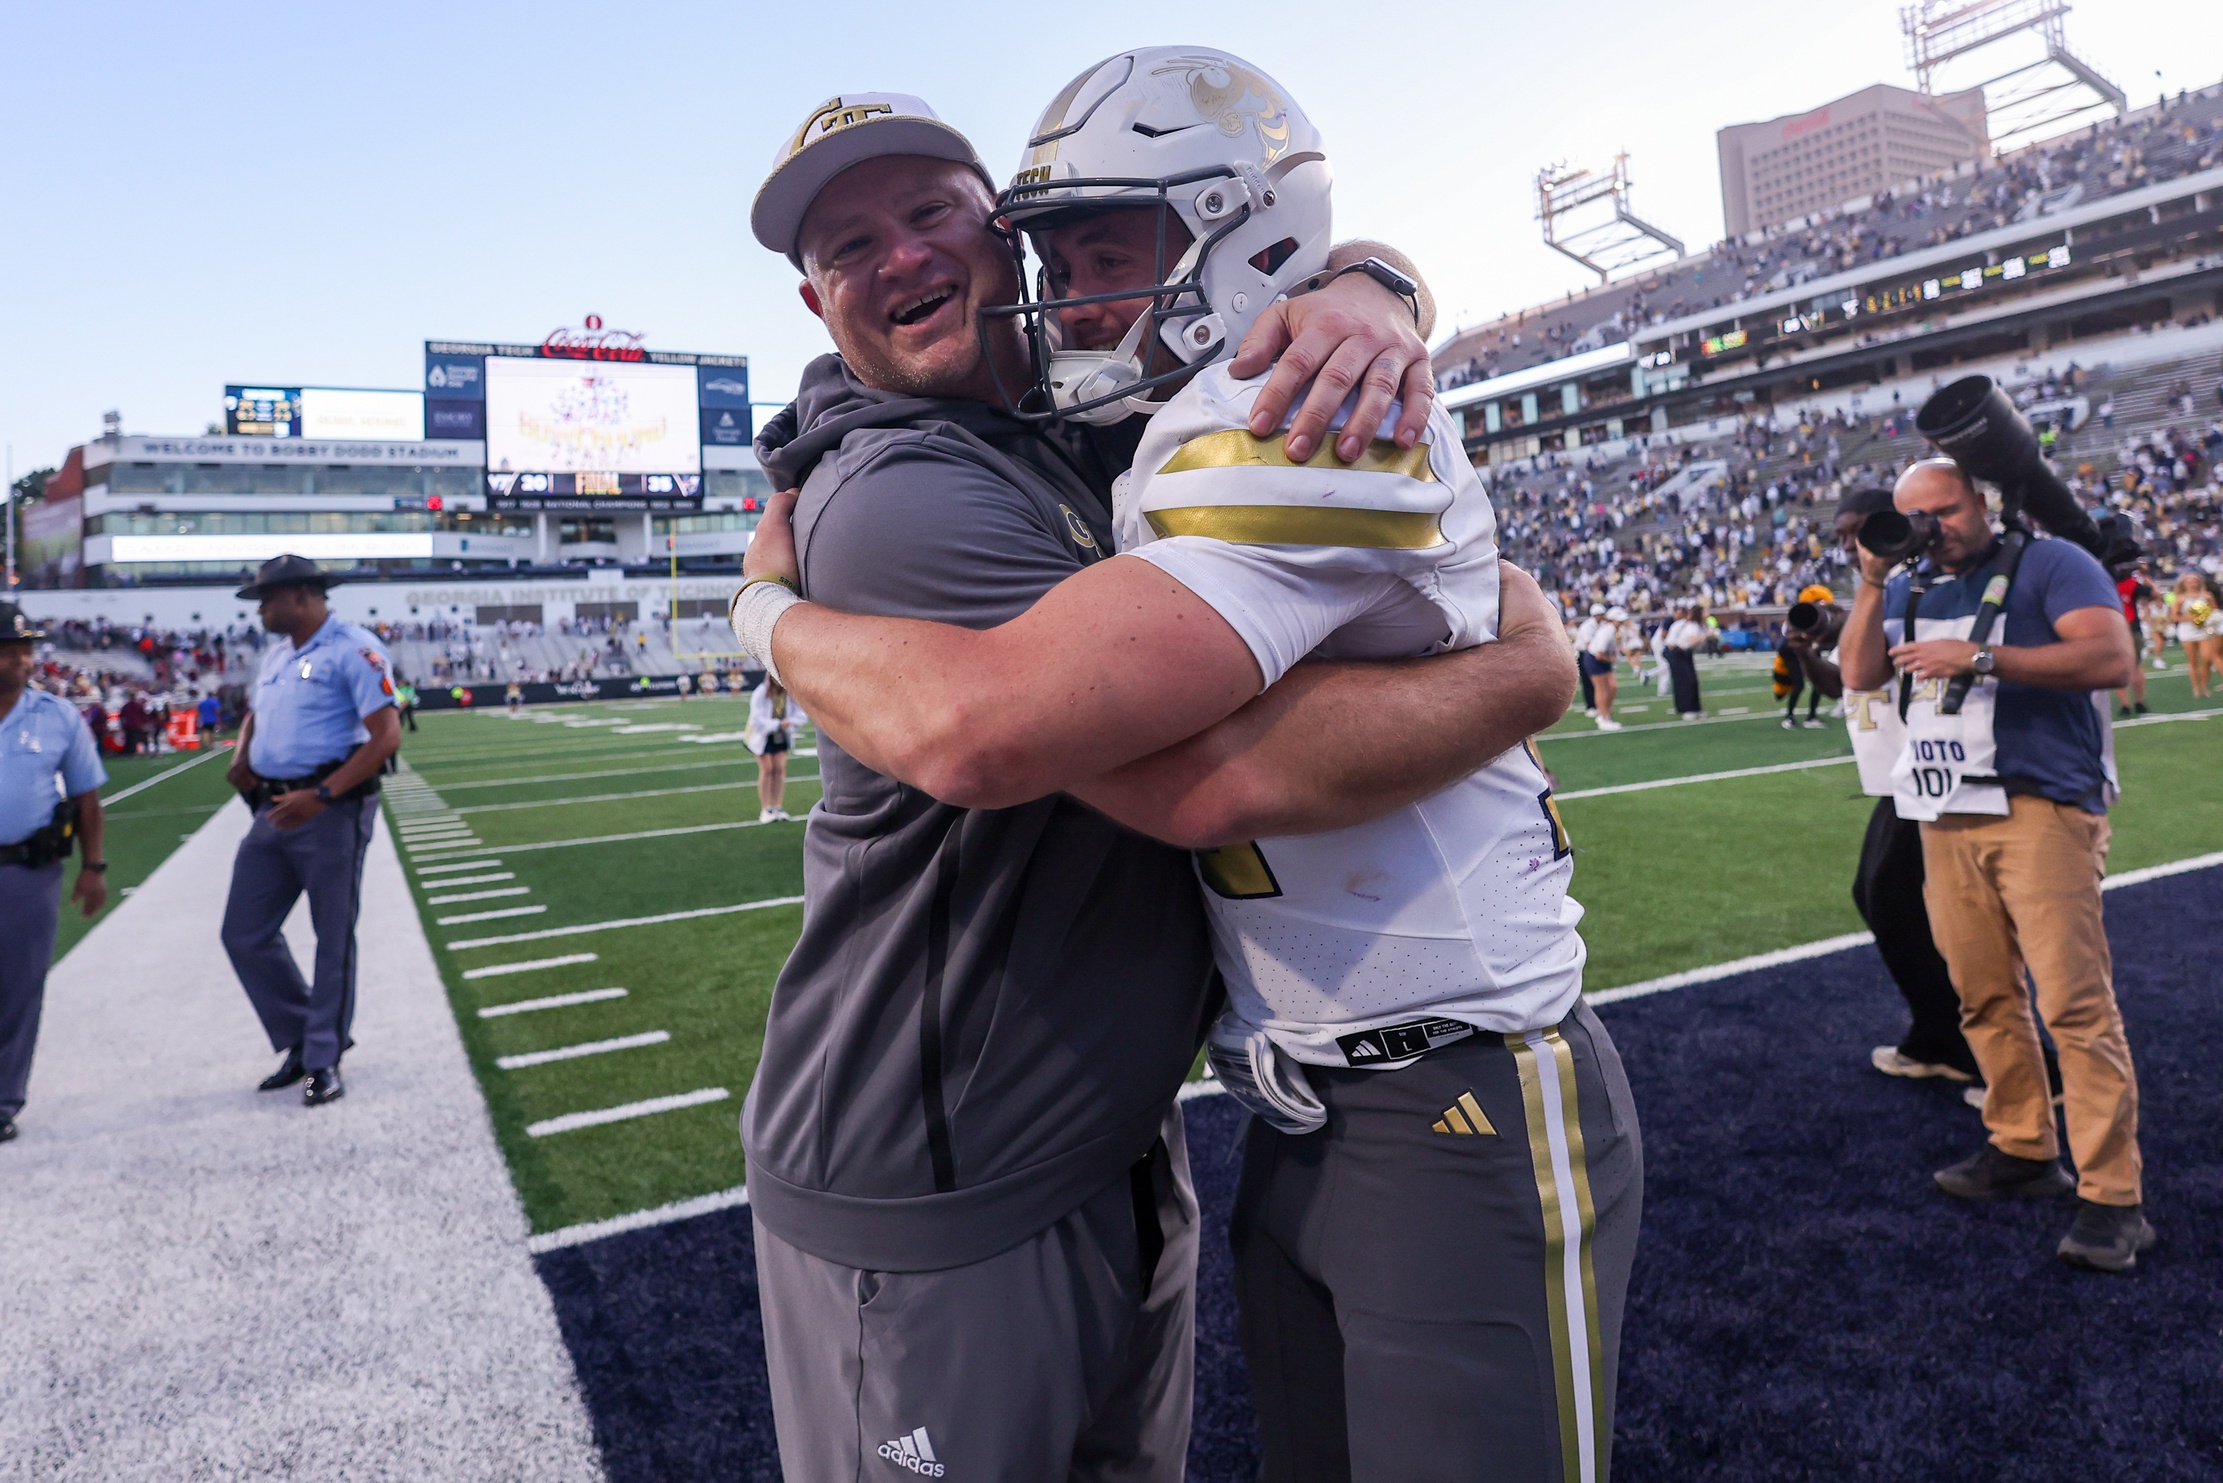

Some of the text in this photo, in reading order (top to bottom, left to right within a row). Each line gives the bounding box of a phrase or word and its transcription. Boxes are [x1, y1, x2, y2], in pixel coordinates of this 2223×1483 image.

[1015, 165, 1051, 201] TECH
[429, 342, 535, 356] GEORGIA TECH
[541, 328, 647, 362] Coca-Cola
[650, 351, 747, 368] YELLOW JACKETS
[143, 443, 459, 459] WELCOME TO BOBBY DODD STADIUM
[520, 474, 548, 491] 20
[406, 582, 734, 606] GEORGIA INSTITUTE OF TECHNO
[1403, 1041, 1412, 1051] L
[877, 1444, 945, 1478] adidas
